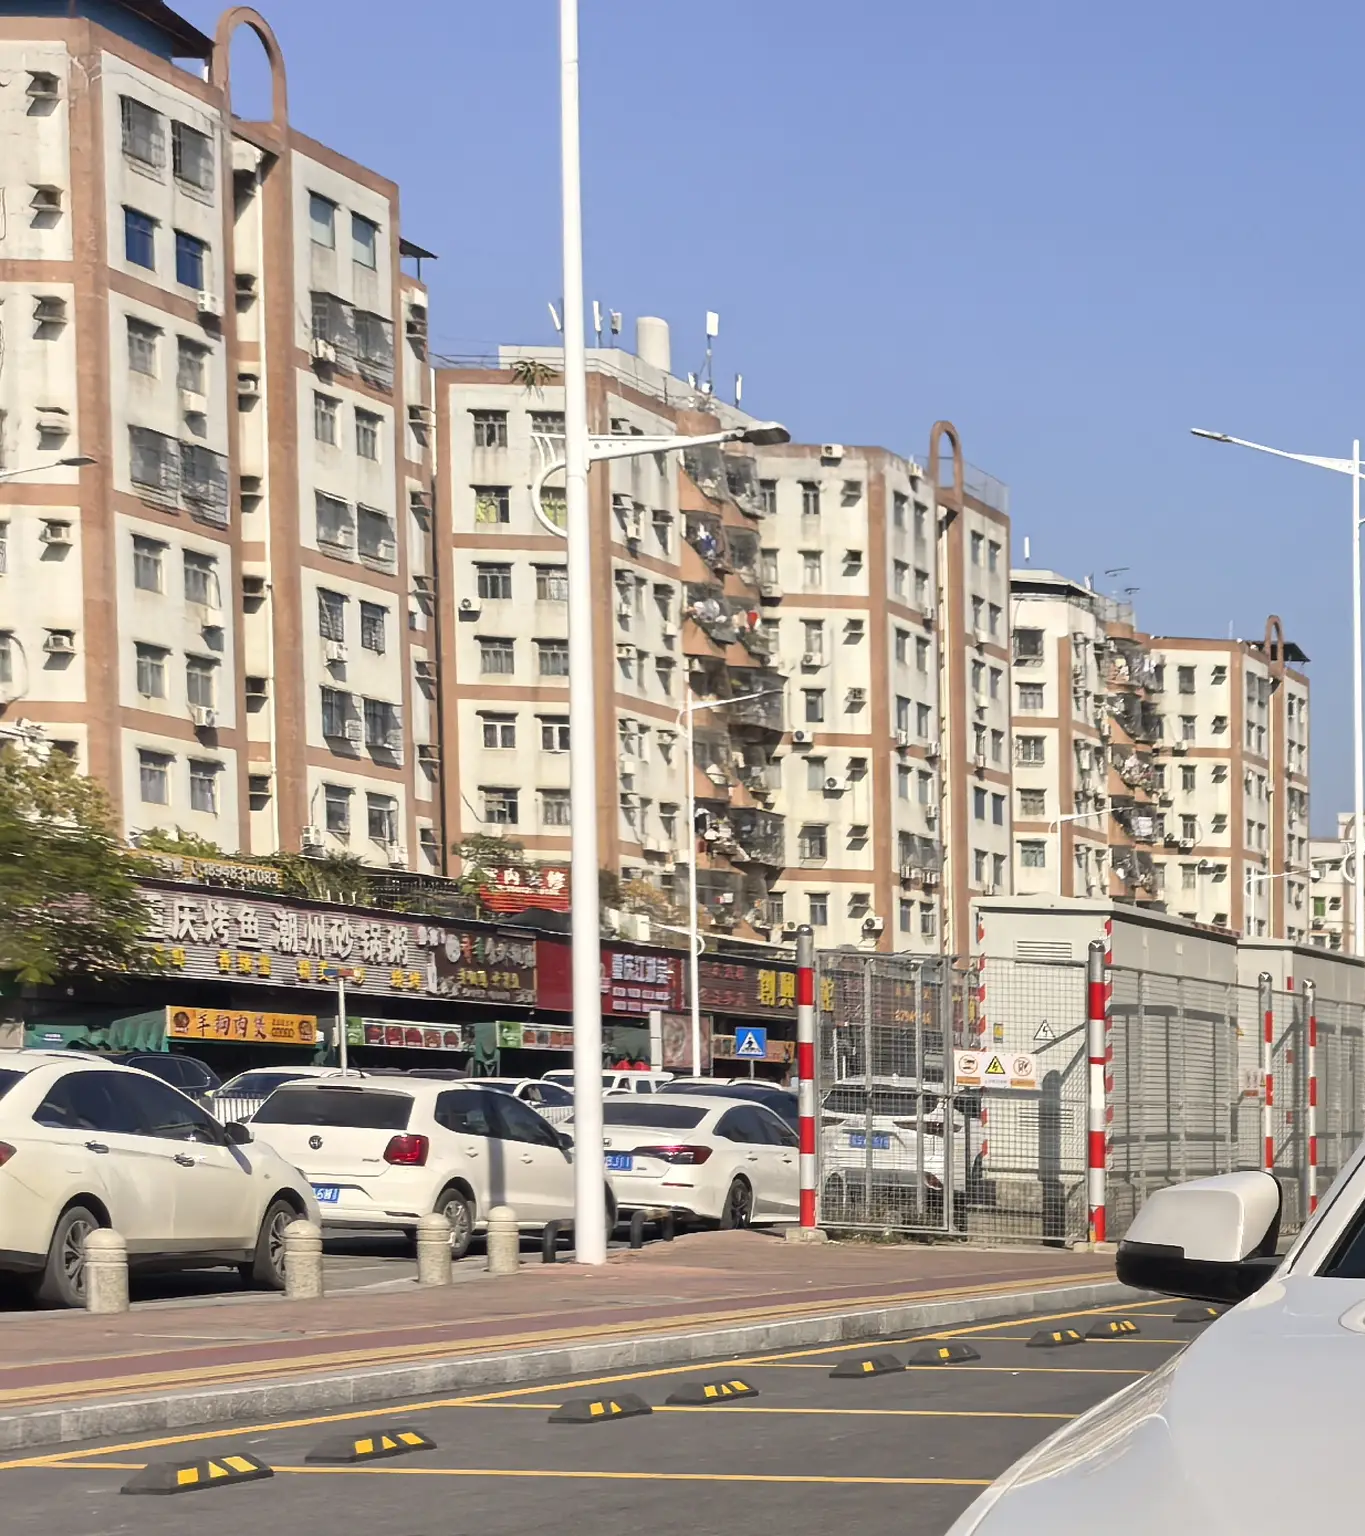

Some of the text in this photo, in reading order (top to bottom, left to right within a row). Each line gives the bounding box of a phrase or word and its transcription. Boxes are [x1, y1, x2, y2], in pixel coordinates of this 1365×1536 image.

[271, 906, 408, 966] 潮州砂锅粥
